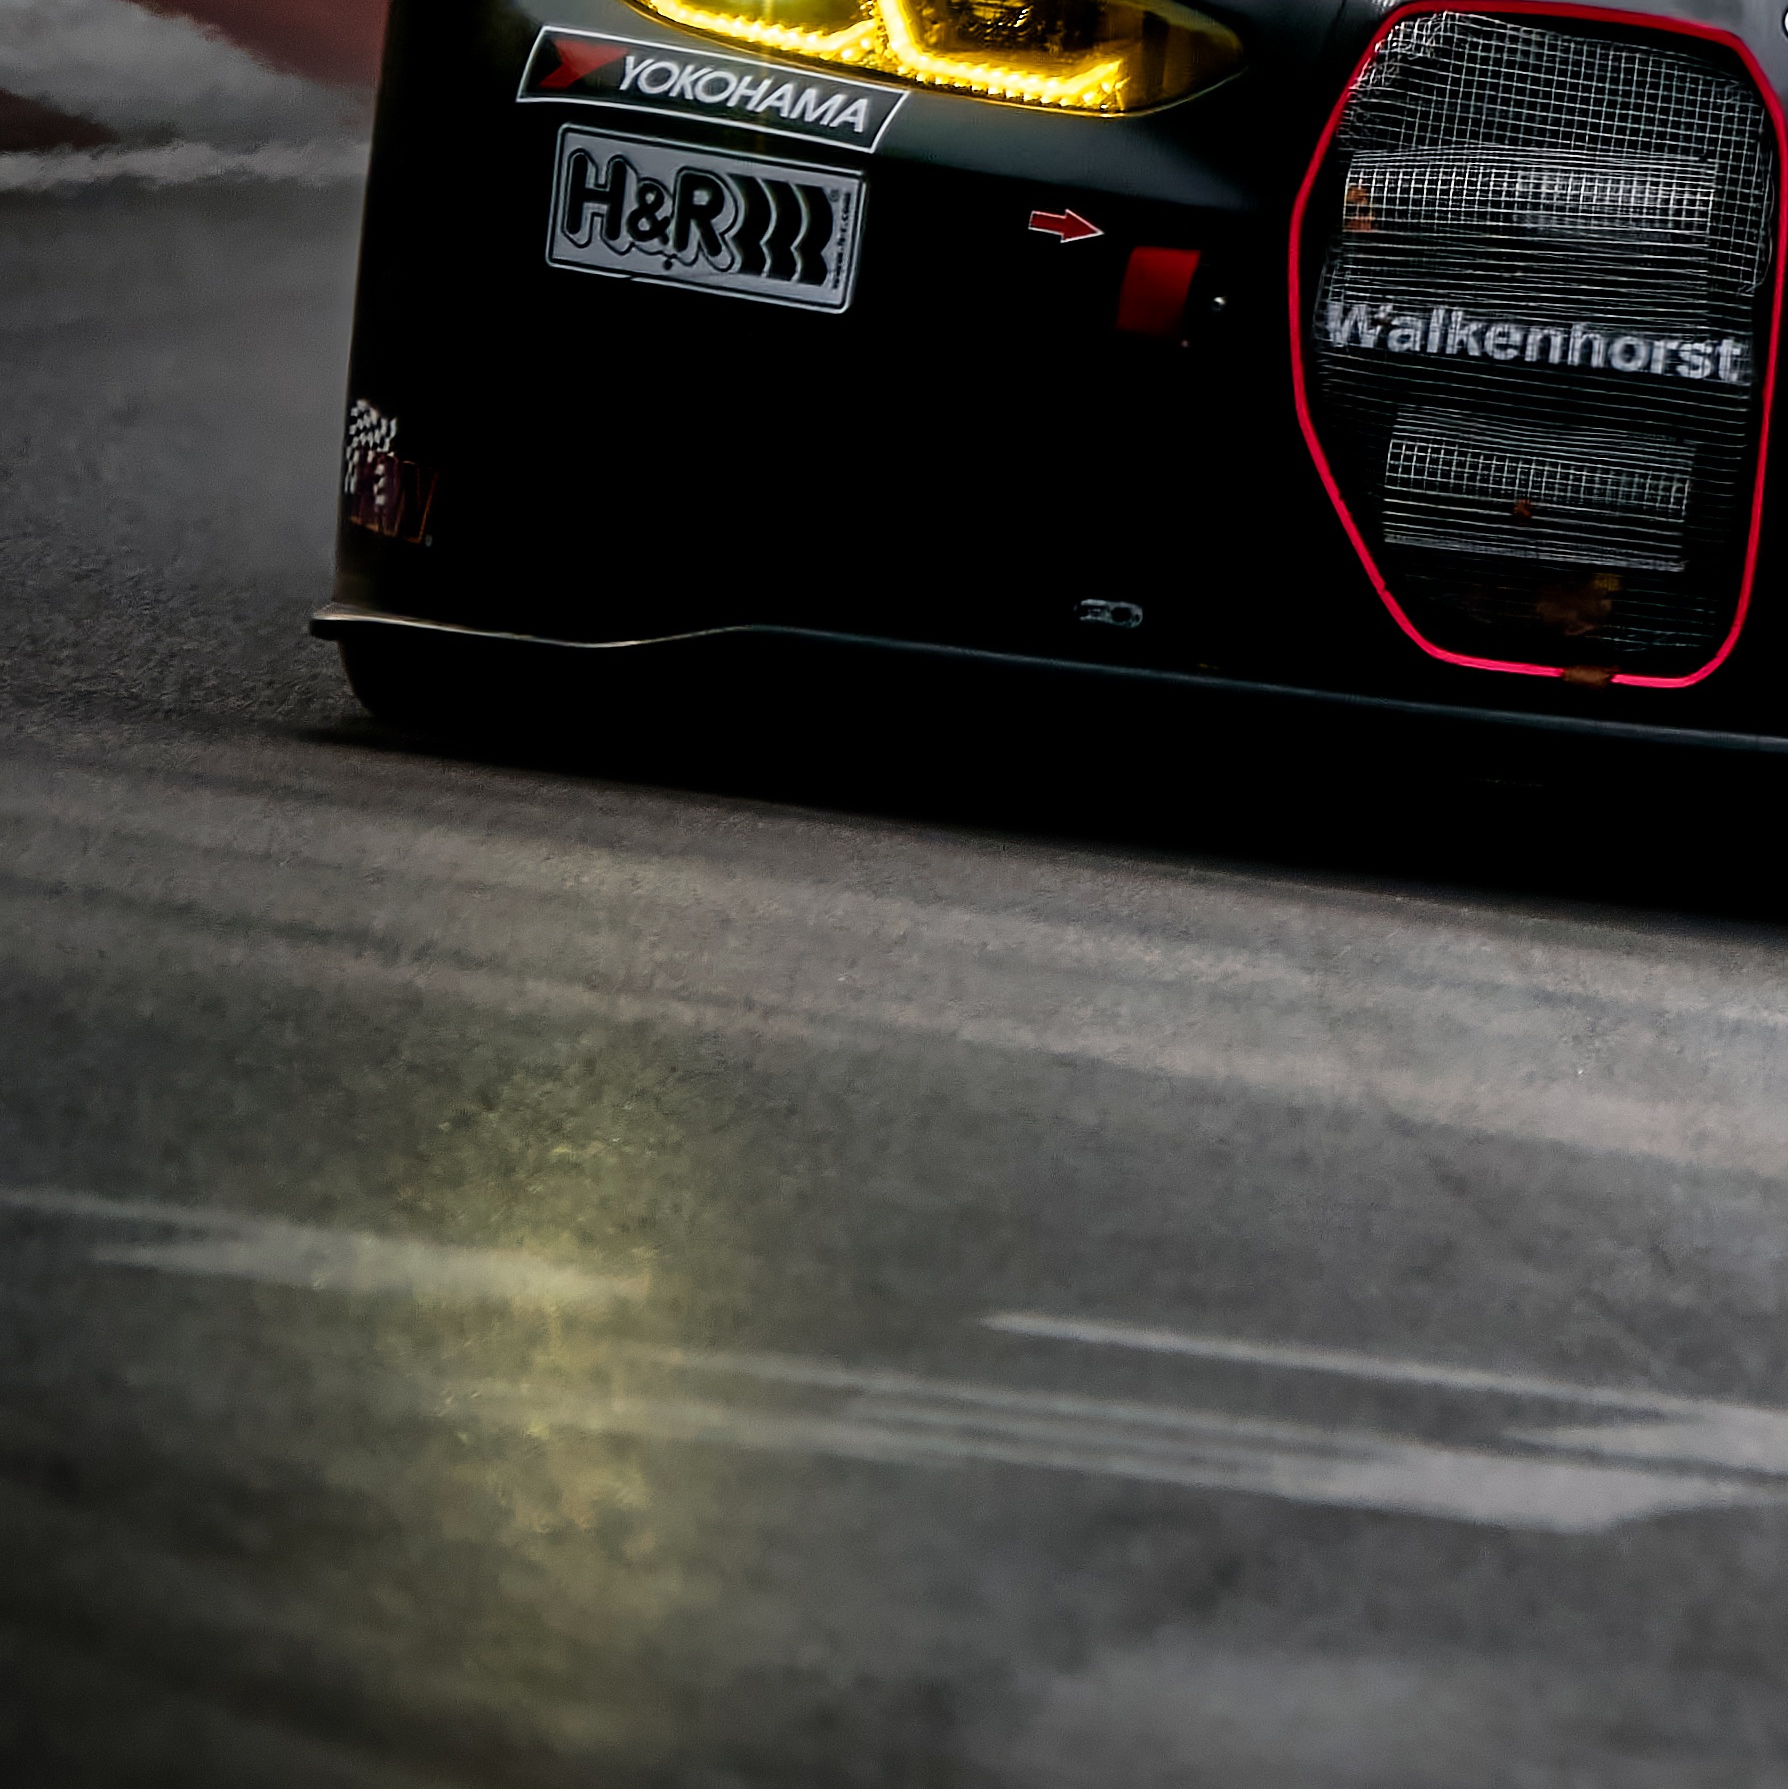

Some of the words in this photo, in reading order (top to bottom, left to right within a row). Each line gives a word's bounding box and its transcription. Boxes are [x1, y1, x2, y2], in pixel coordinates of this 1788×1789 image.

[620, 55, 870, 134] YOKOHAMA
[566, 148, 740, 273] H&R
[1326, 302, 1751, 384] Walkenhorst
